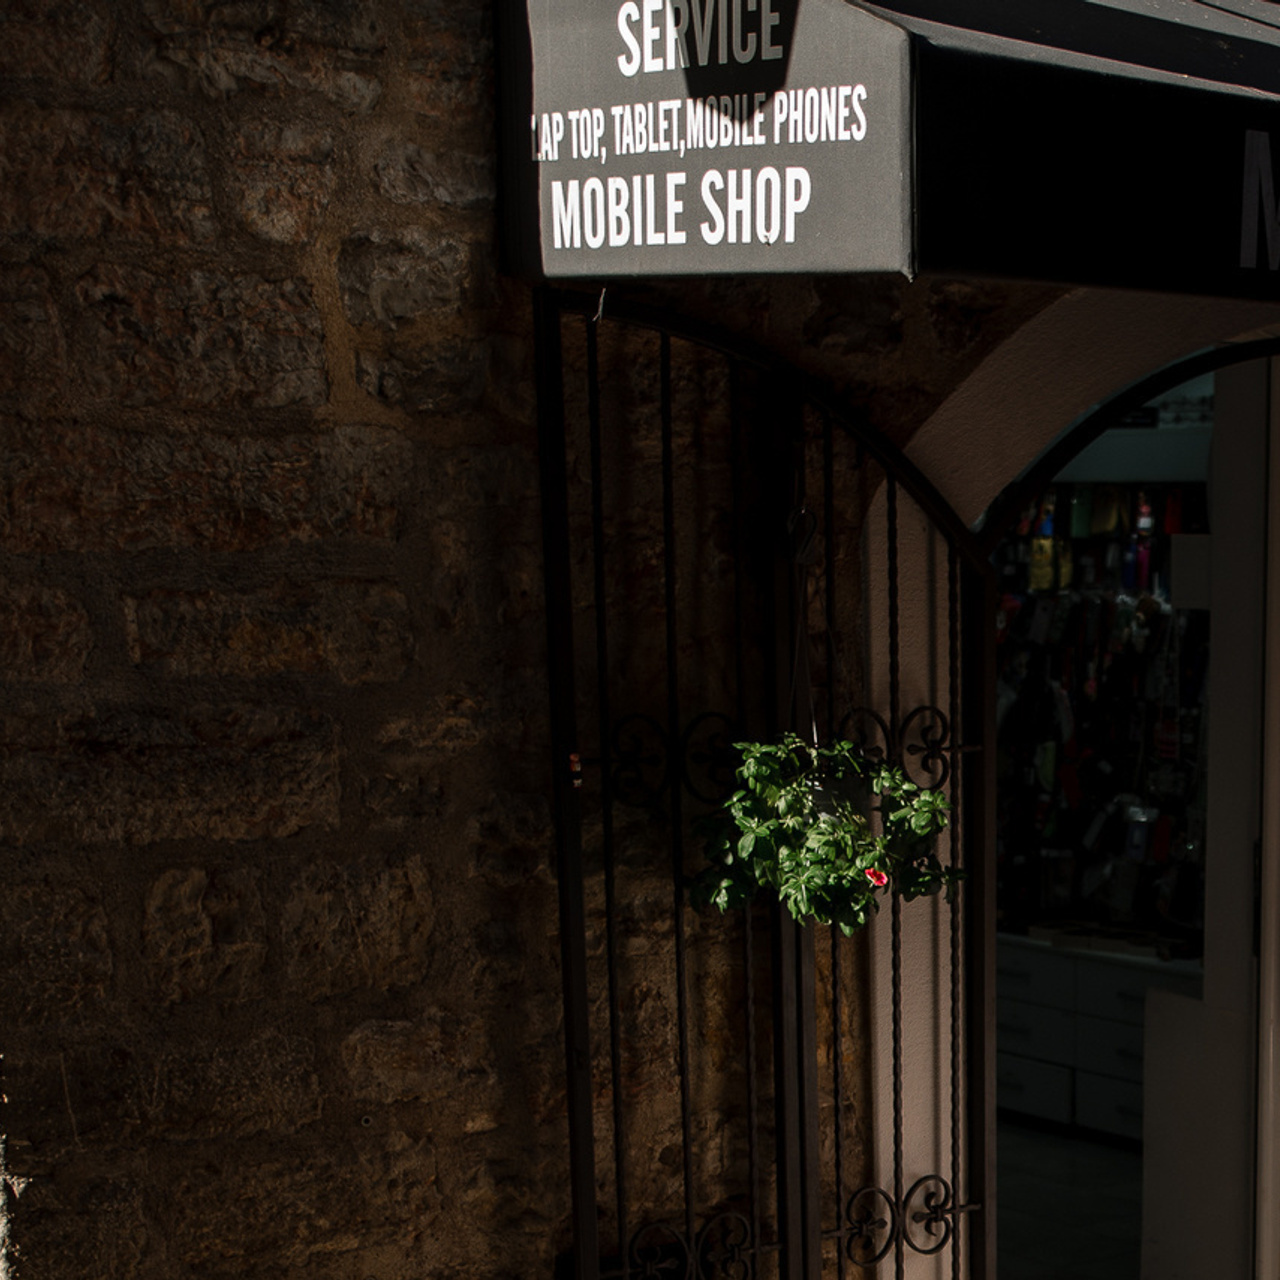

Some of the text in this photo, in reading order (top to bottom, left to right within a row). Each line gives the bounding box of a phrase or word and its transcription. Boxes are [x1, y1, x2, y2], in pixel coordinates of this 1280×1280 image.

[617, 0, 784, 77] SERVICE
[568, 108, 606, 164] TOP,
[774, 84, 868, 144] PHONES
[551, 166, 812, 249] MOBILE SHOP
